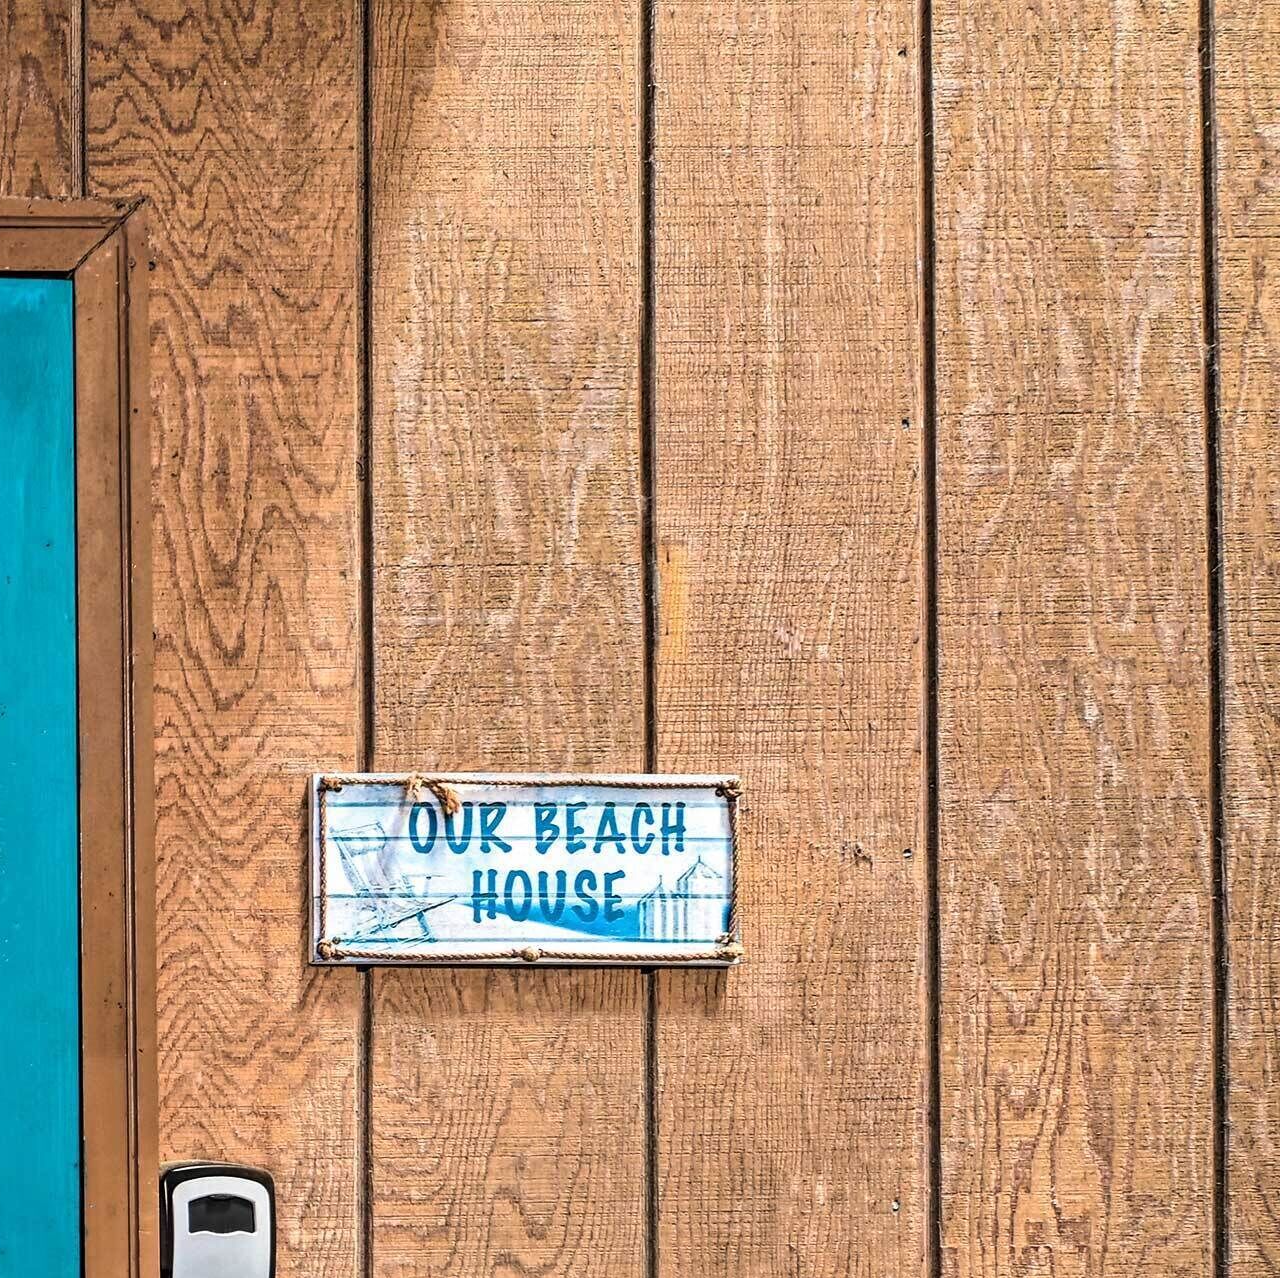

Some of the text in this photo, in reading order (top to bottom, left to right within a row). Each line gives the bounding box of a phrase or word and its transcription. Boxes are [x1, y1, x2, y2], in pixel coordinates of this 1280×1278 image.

[408, 801, 686, 856] OUR BEACH
[471, 869, 627, 924] HOUSE
